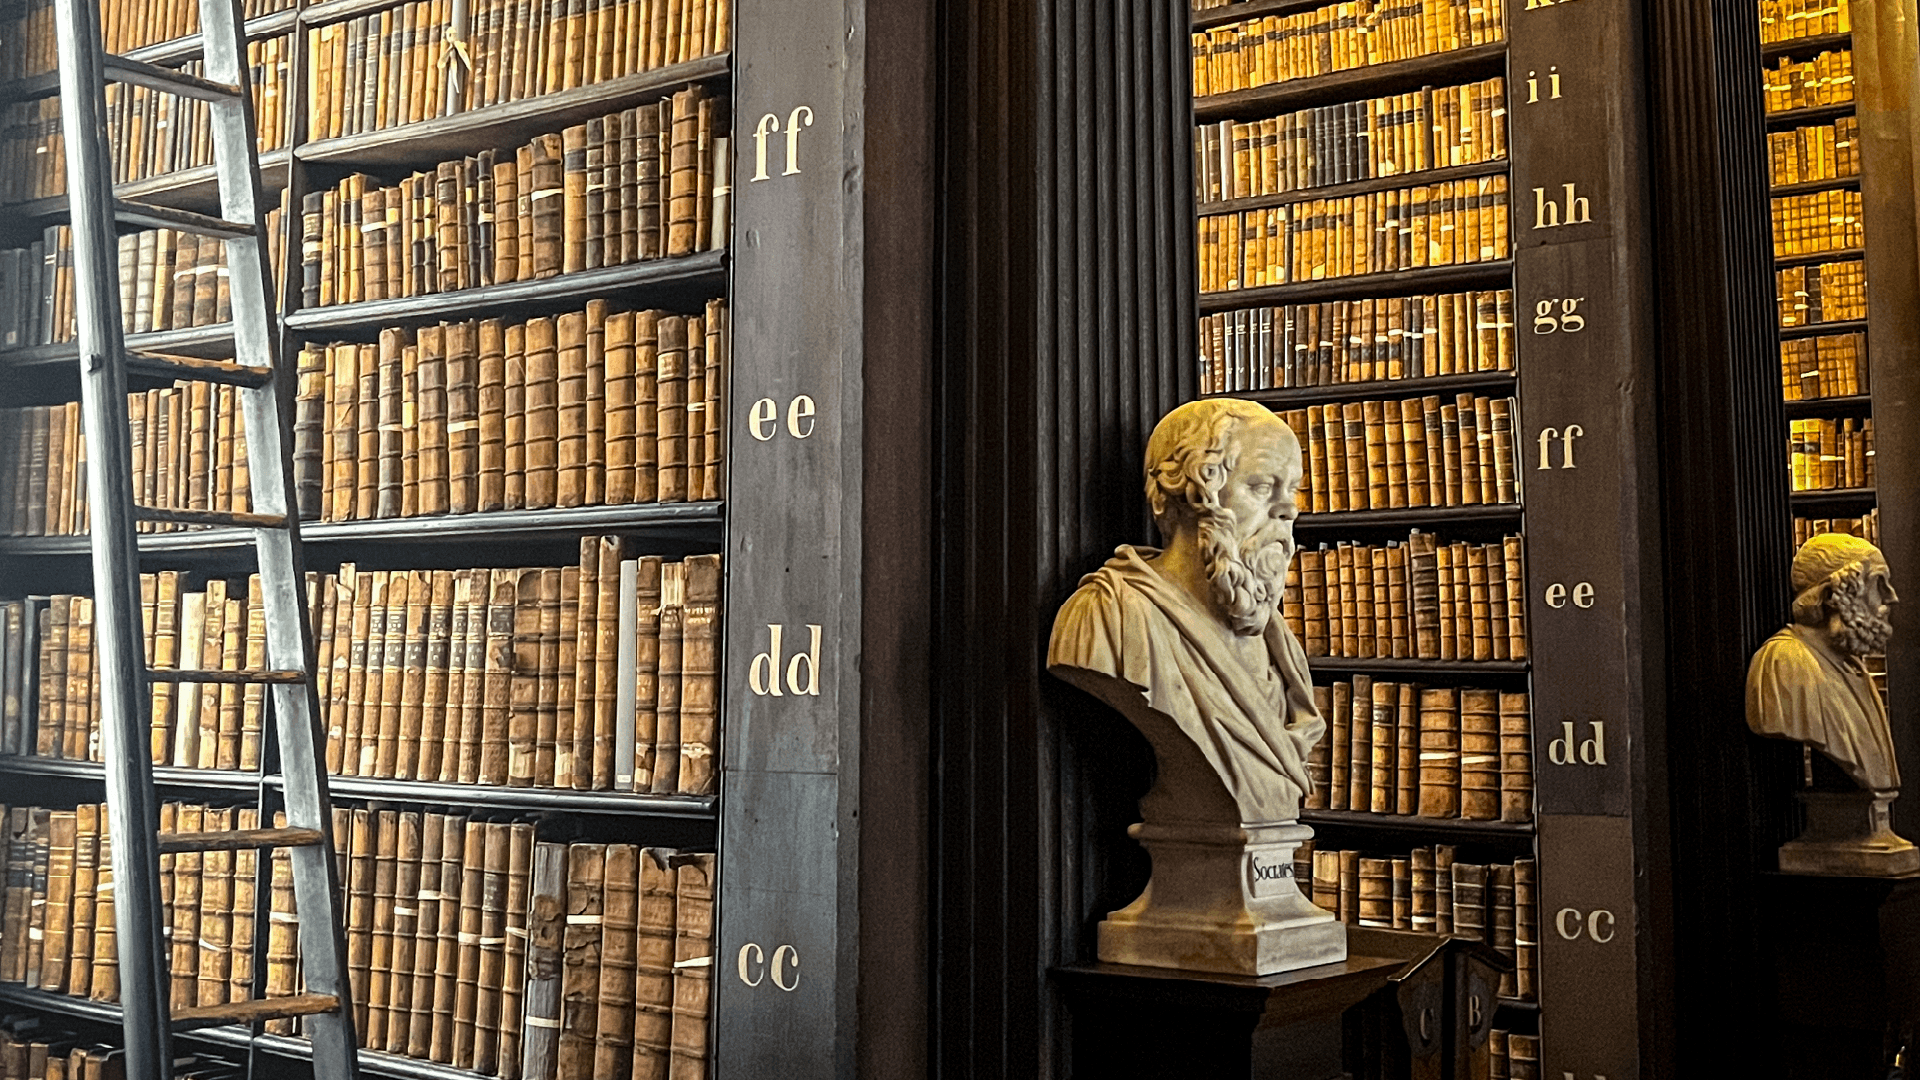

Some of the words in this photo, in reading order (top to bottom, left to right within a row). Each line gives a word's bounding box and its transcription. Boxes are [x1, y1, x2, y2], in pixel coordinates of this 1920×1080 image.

[1527, 67, 1562, 104] ii
[751, 106, 814, 183] ff
[1533, 183, 1592, 230] hh
[1534, 298, 1585, 335] gg
[749, 396, 815, 441] ee
[1538, 425, 1584, 470] ff
[1546, 583, 1594, 609] ee
[749, 625, 822, 697] dd
[1549, 721, 1607, 766] dd
[1557, 908, 1615, 944] cc
[739, 943, 800, 992] cc
[1469, 995, 1482, 1027] B
